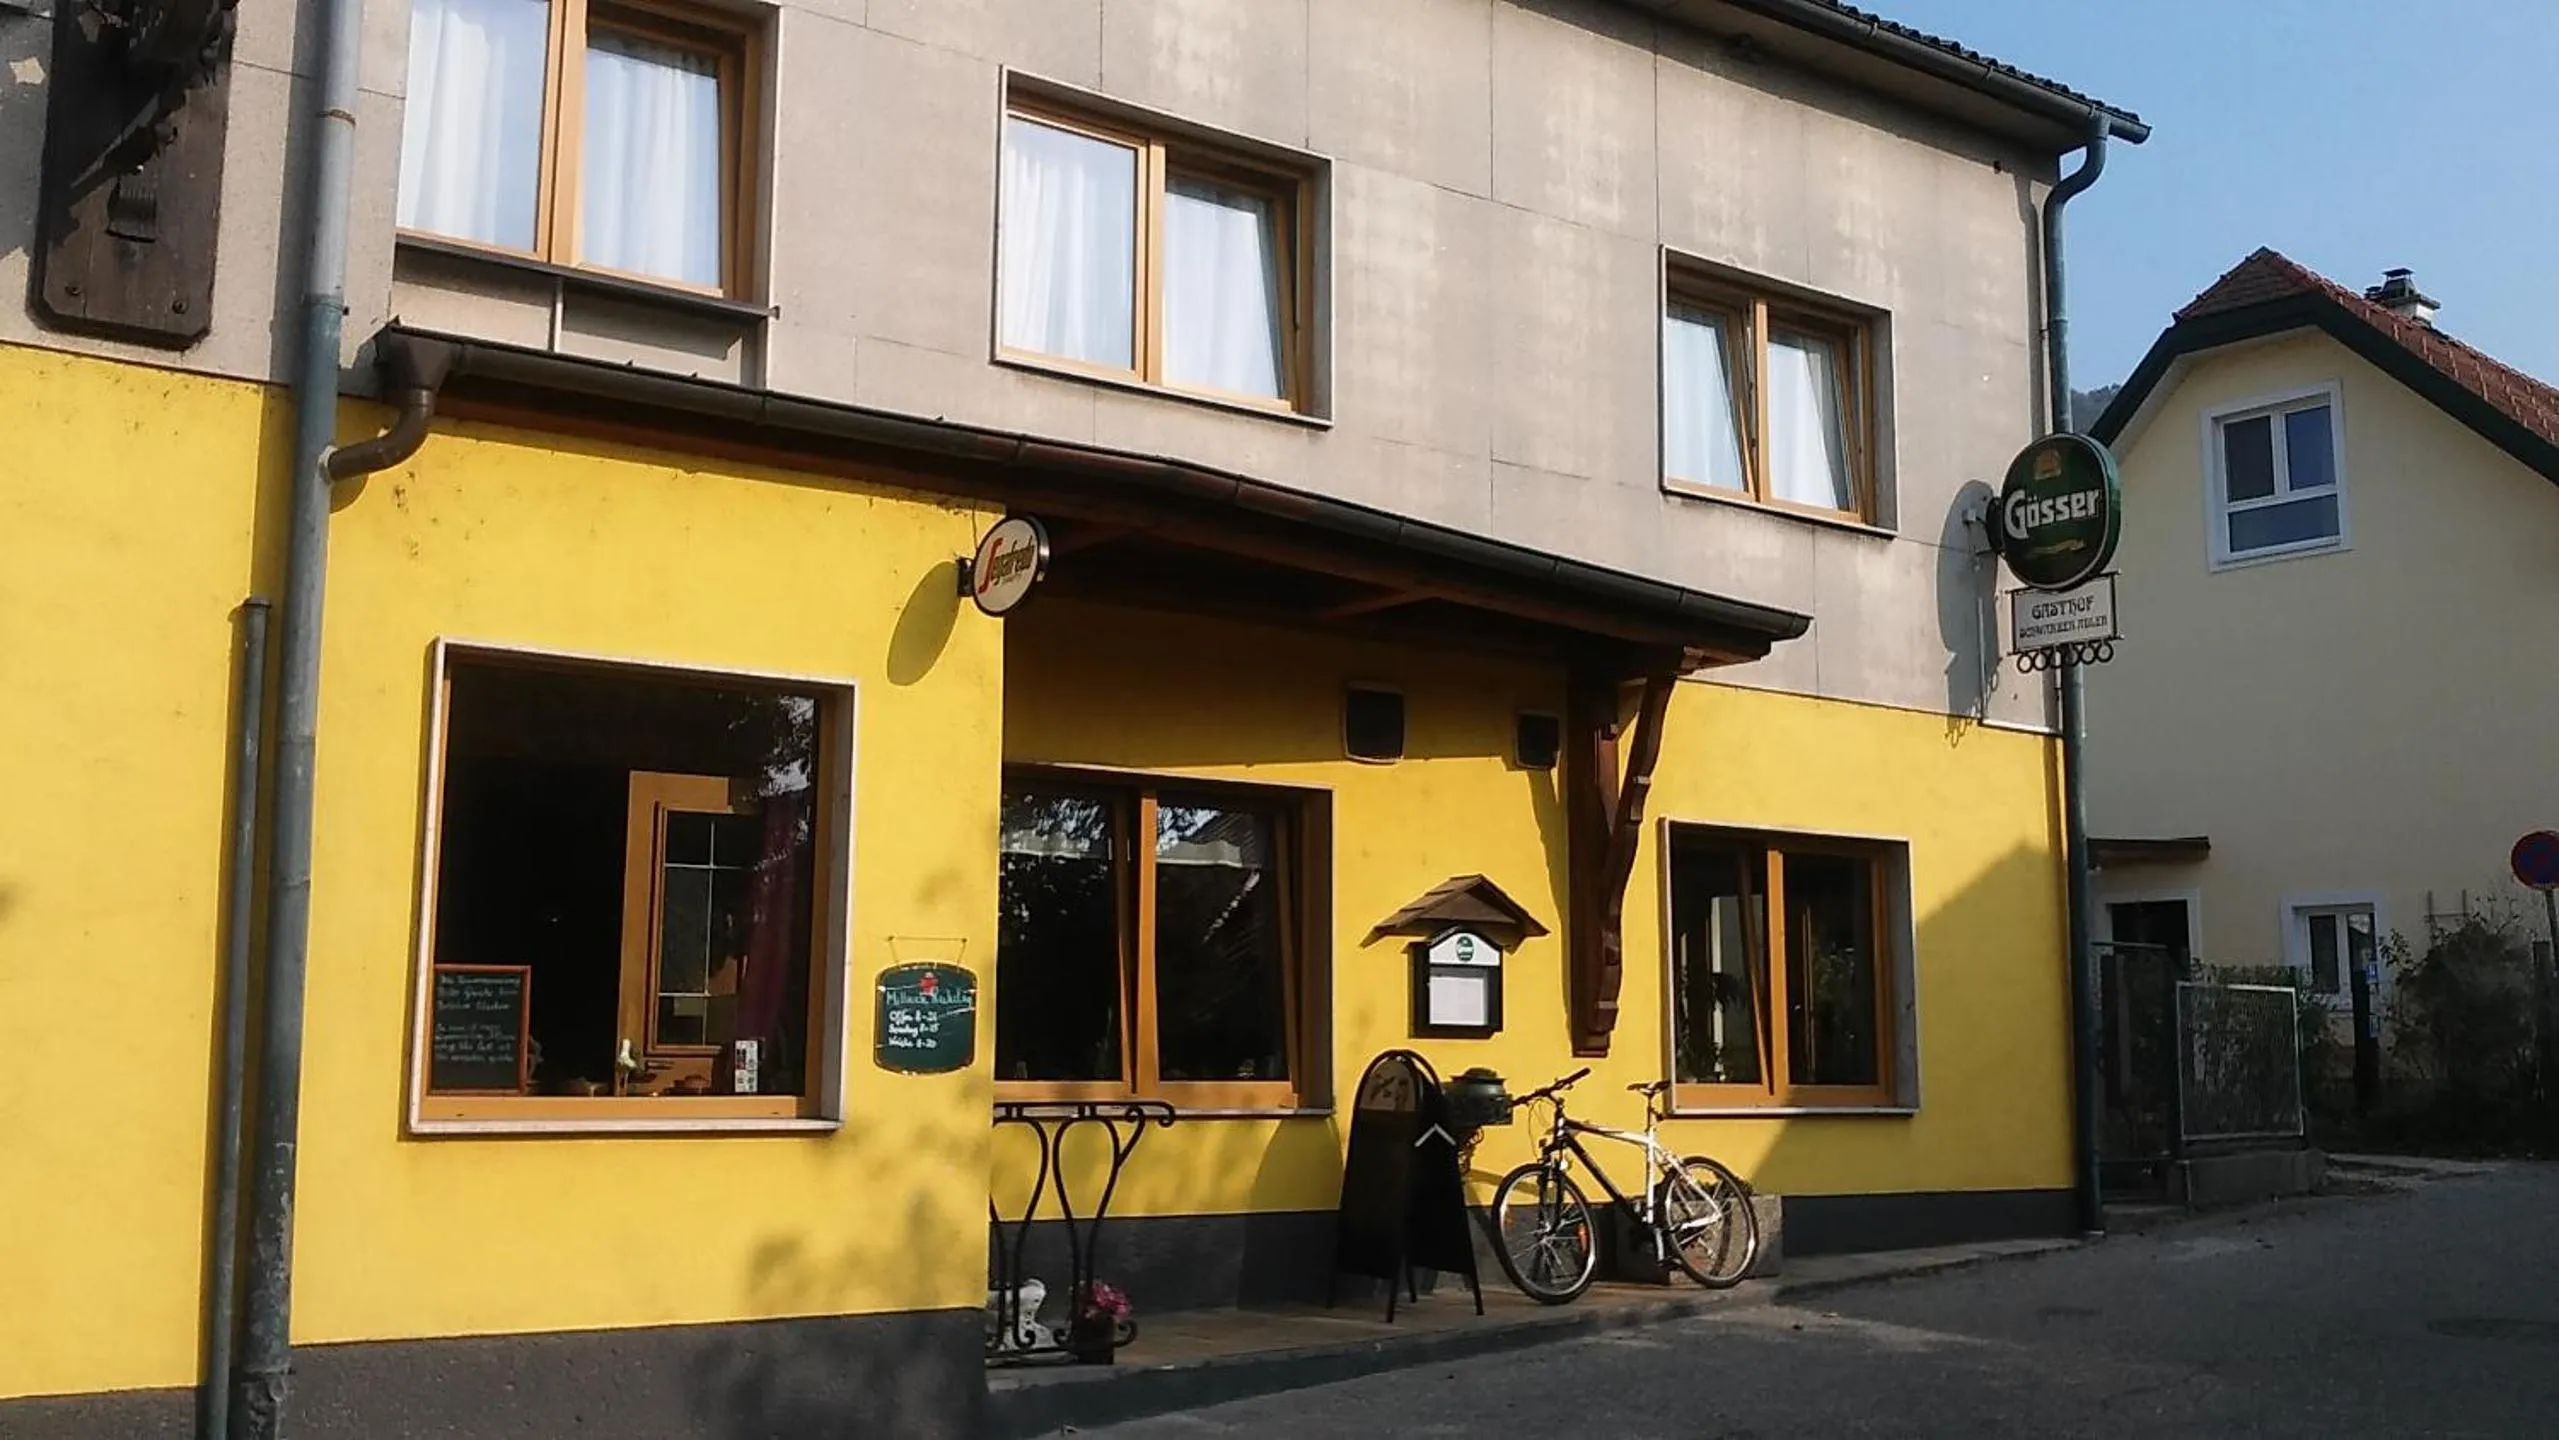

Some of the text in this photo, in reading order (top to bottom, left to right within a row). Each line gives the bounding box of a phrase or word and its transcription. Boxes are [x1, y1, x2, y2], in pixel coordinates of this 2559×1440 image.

[2004, 488, 2101, 540] Gösser
[978, 535, 1036, 594] Segafredo
[2031, 595, 2094, 620] GASTHOF
